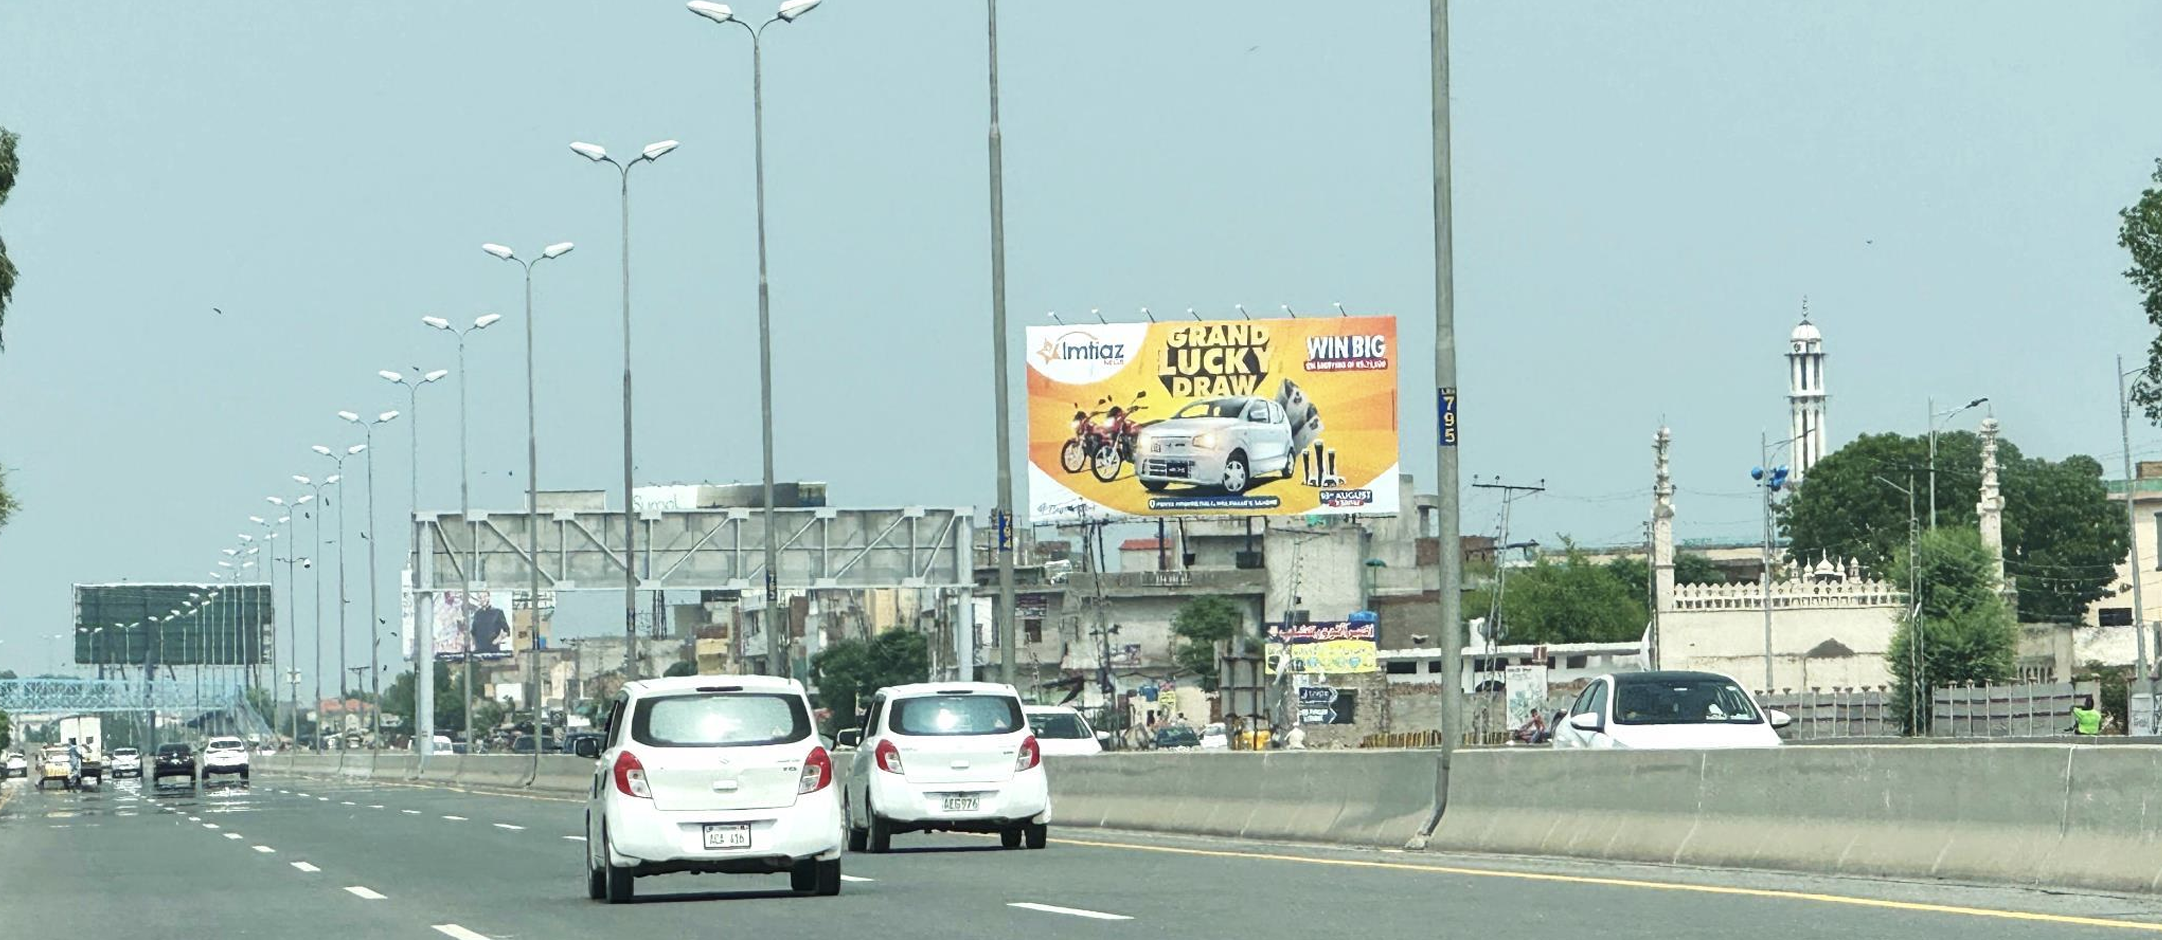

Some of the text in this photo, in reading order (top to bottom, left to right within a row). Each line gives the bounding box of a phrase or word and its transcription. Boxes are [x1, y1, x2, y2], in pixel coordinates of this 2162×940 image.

[1166, 324, 1271, 348] GRAND
[1306, 334, 1386, 359] WIN BIG
[1063, 341, 1125, 360] Imtiaz
[1158, 346, 1274, 376] LUCKY
[1172, 374, 1258, 398] DRAW
[1442, 396, 1455, 443] 795
[1335, 490, 1371, 500] AUGUST
